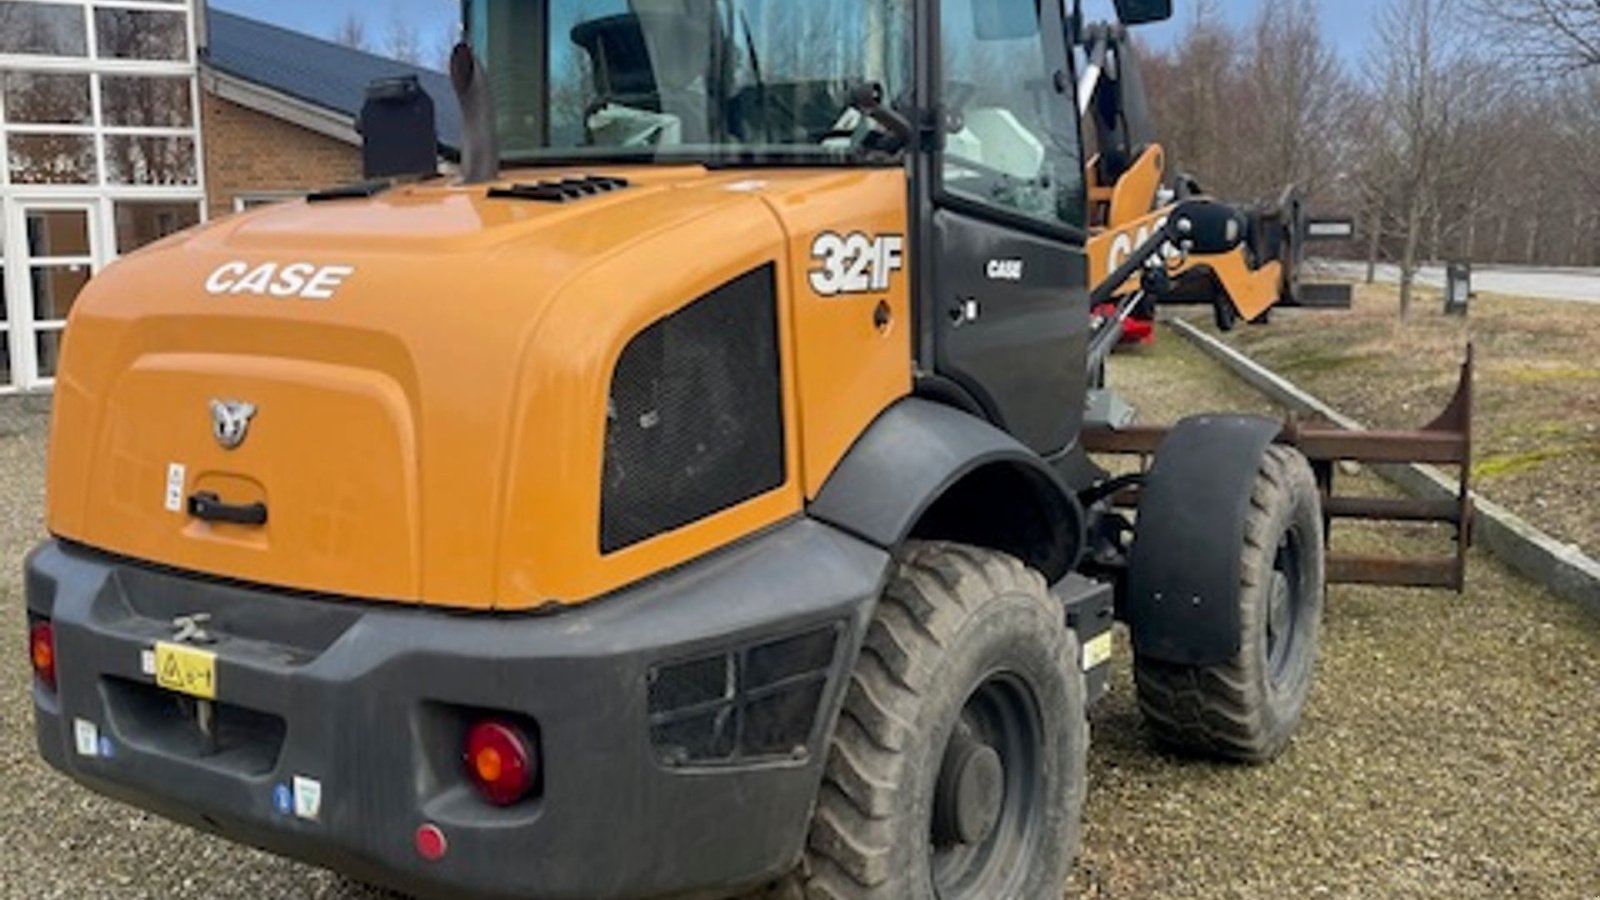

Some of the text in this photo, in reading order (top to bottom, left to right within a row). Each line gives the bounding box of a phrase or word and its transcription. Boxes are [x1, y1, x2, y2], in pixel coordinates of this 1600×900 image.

[205, 261, 354, 299] CASE
[808, 230, 904, 297] 321F
[986, 259, 1022, 279] CASE
